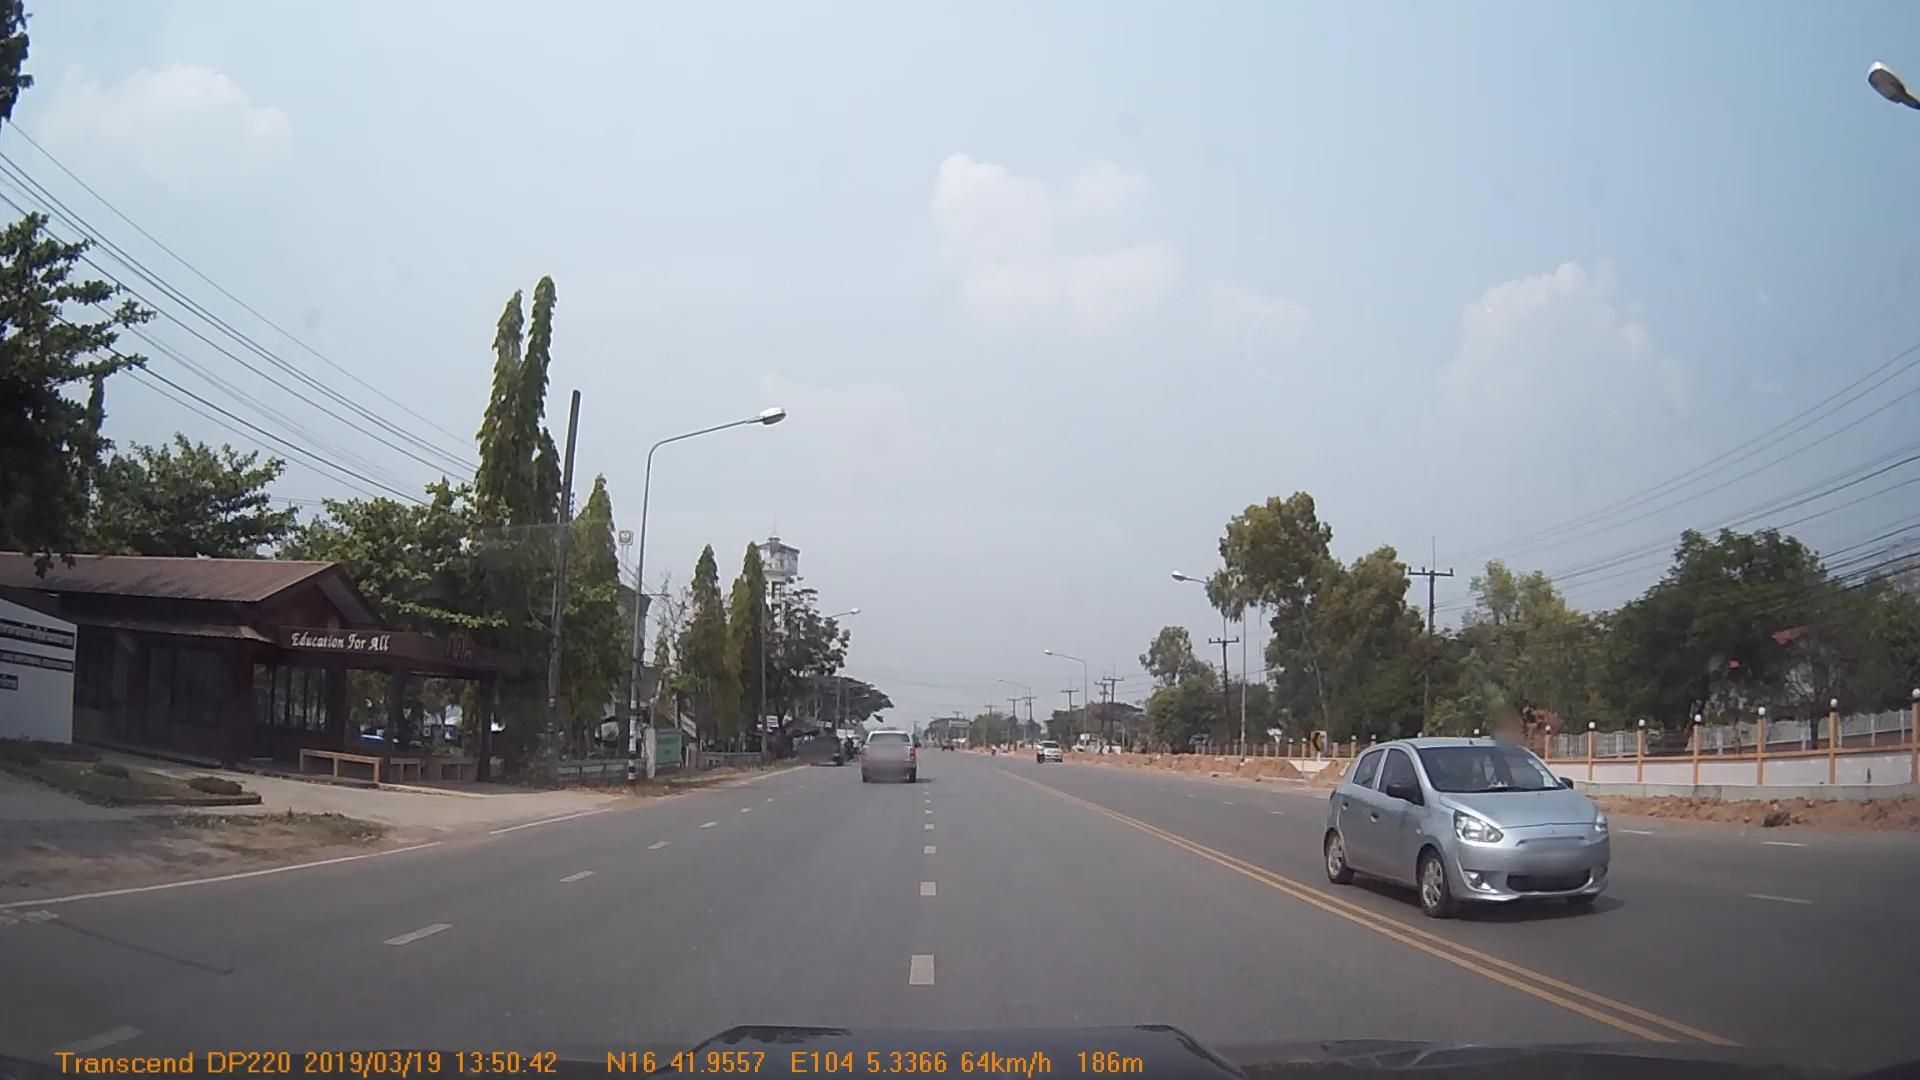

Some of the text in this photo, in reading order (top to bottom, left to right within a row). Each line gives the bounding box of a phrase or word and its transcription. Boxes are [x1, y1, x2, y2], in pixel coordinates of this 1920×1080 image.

[291, 631, 390, 651] Education For All
